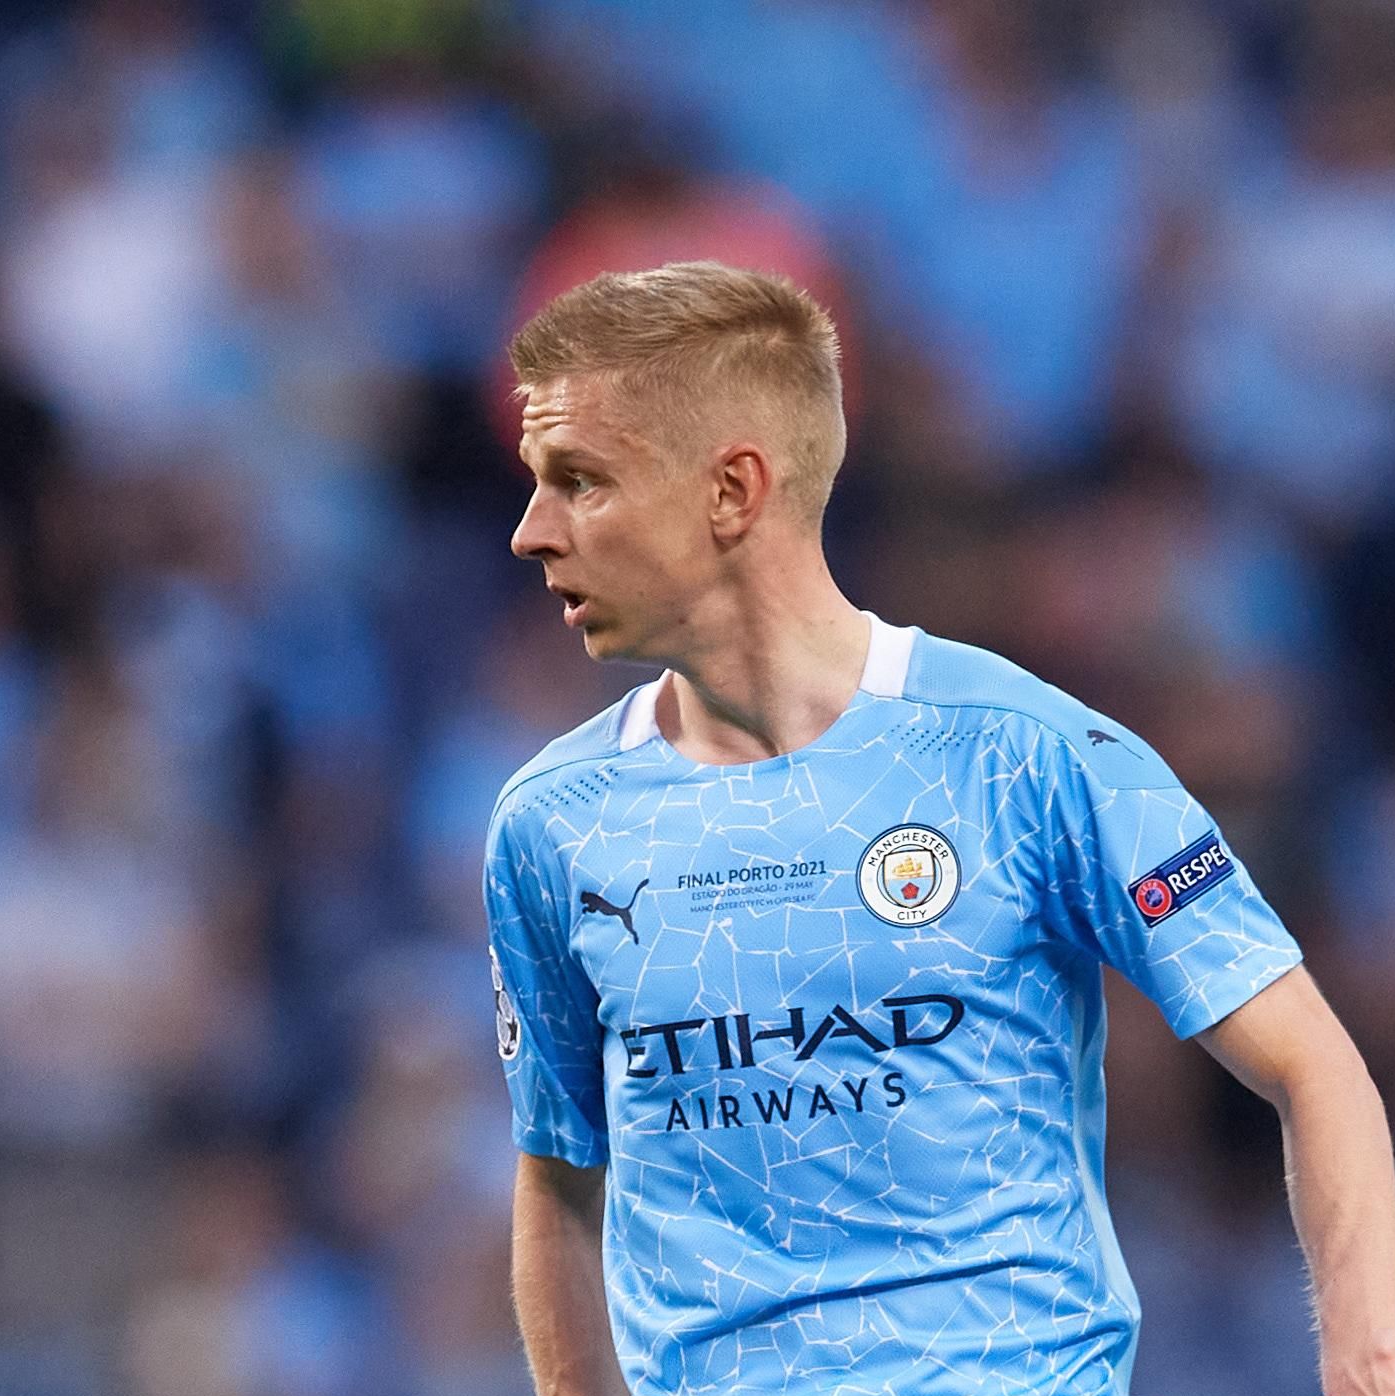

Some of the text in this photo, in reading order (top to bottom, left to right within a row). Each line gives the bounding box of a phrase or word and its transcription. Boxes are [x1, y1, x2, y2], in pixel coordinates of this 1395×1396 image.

[868, 832, 949, 867] MANCHESTER
[678, 860, 827, 889] FINAL PORTO 2021
[795, 881, 814, 889] MAY
[896, 909, 927, 921] CITY
[620, 993, 965, 1078] ETIHAD
[666, 1072, 906, 1132] AIRWAYS
